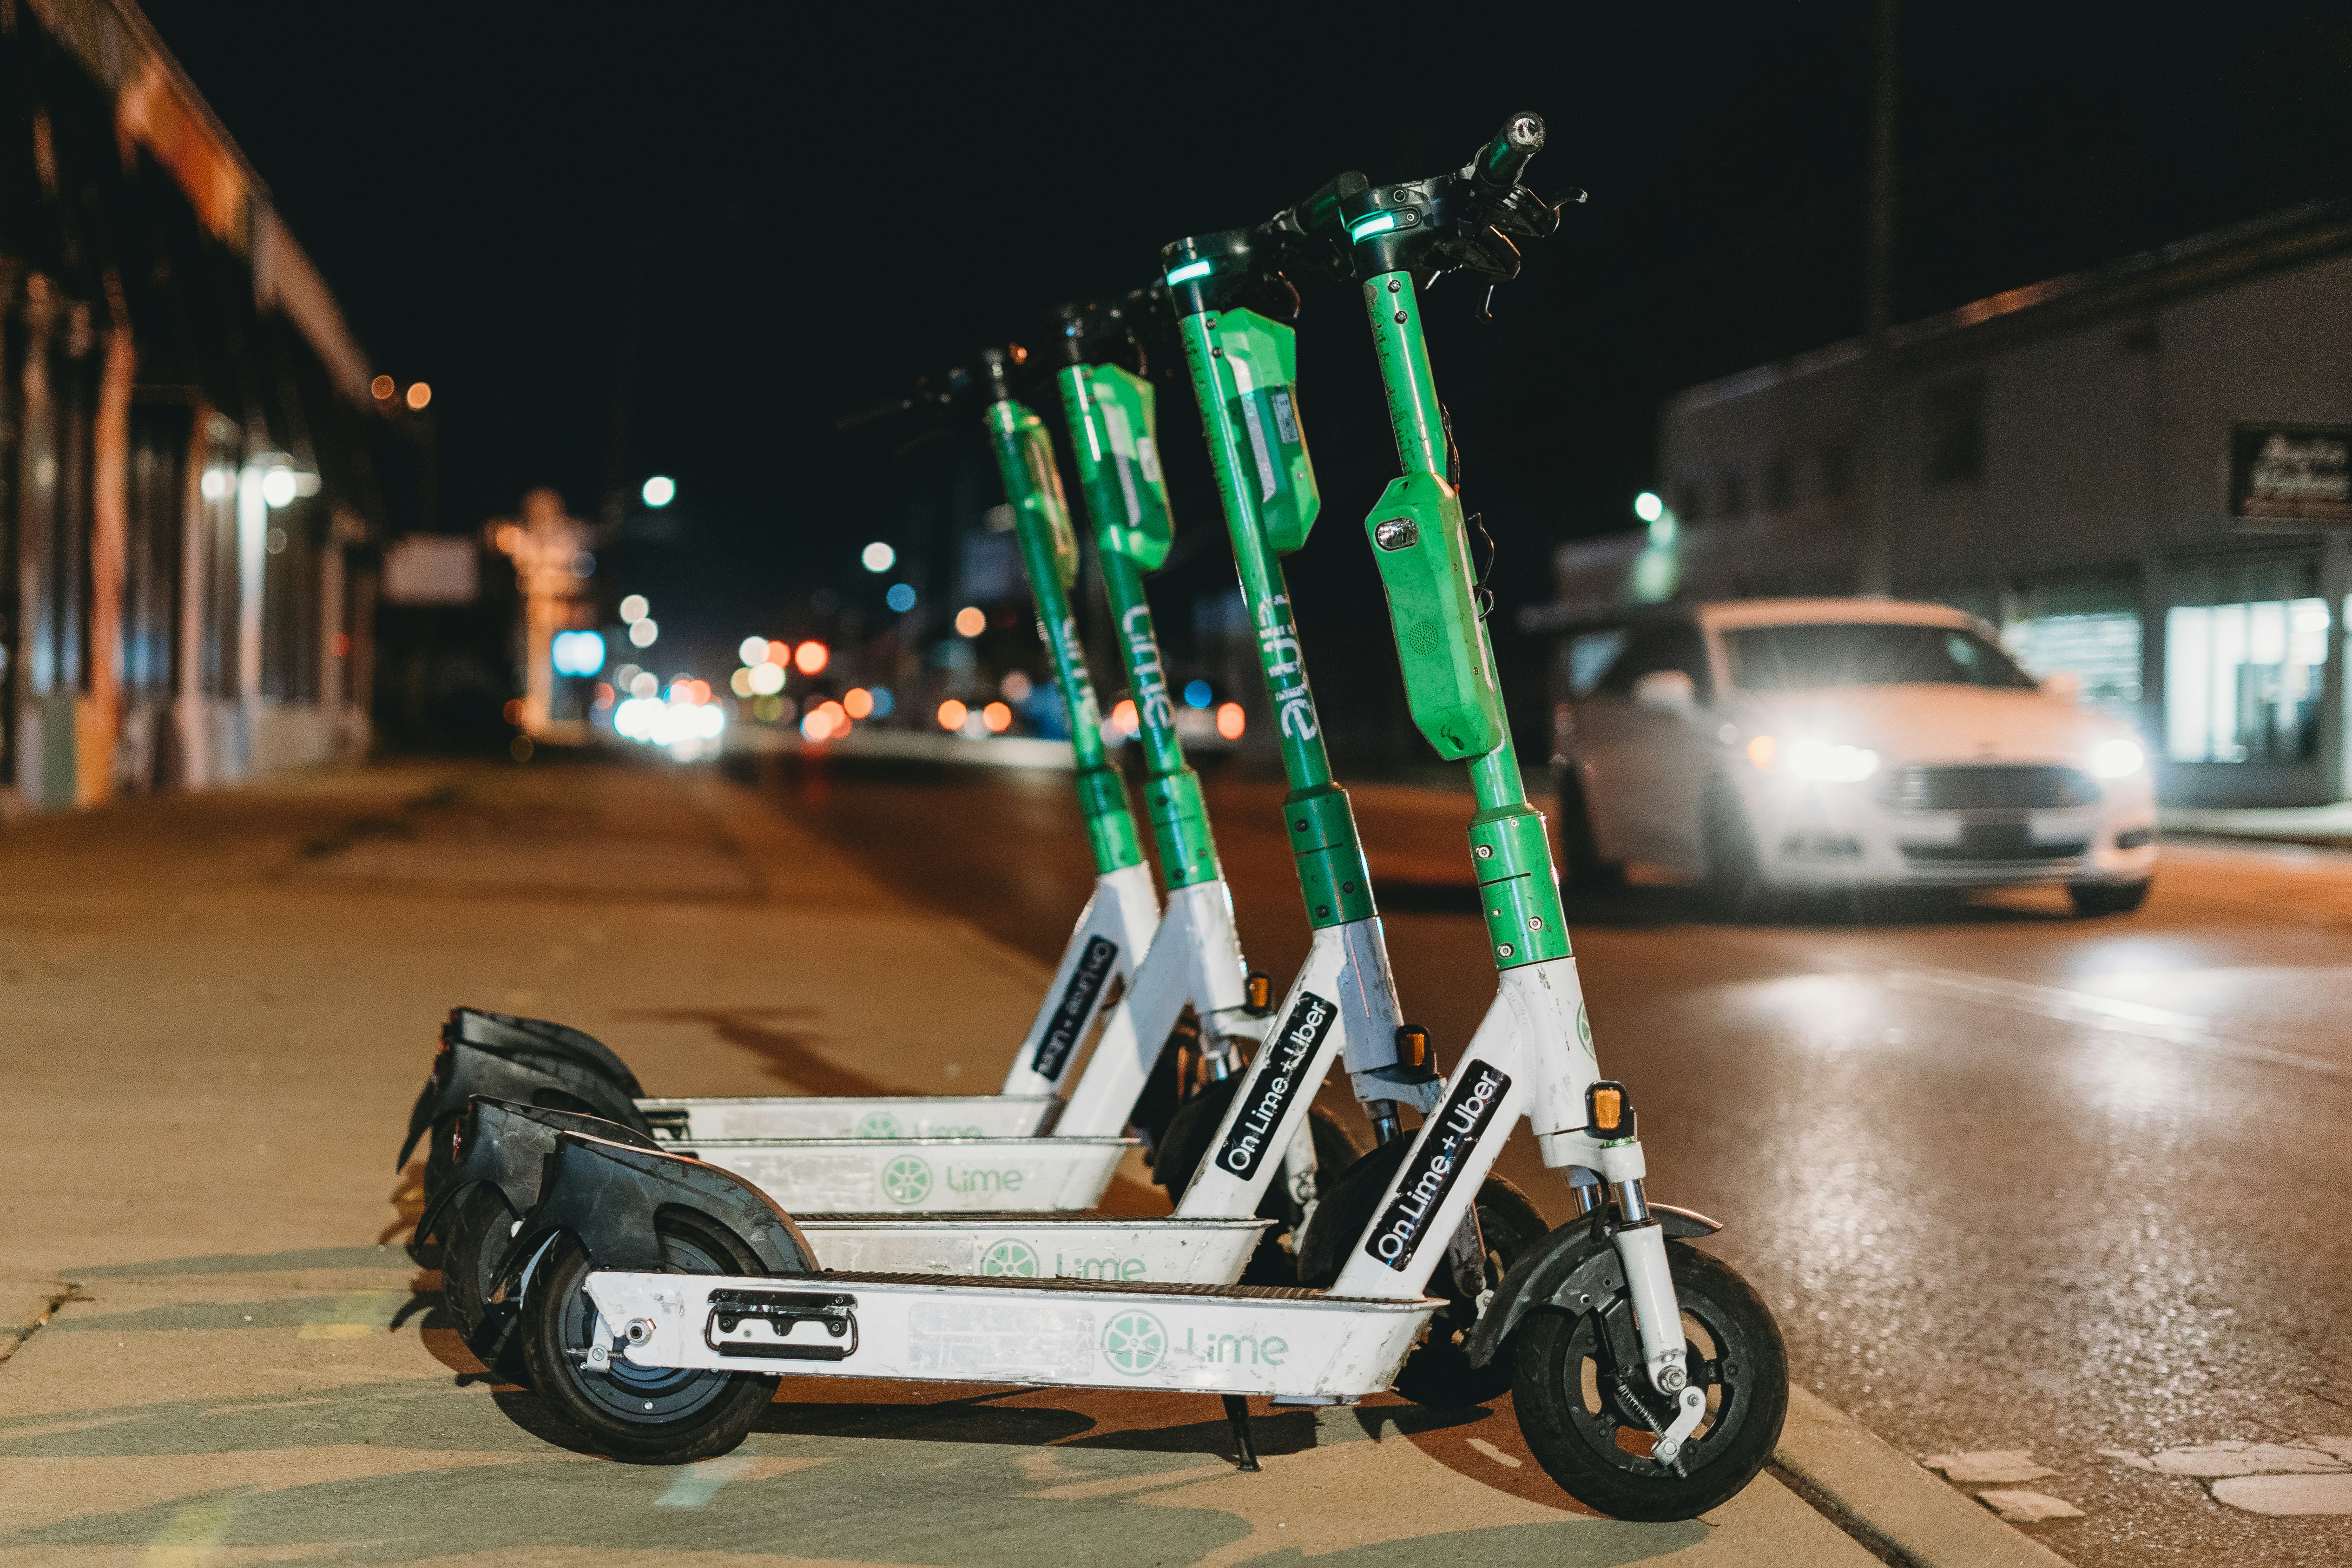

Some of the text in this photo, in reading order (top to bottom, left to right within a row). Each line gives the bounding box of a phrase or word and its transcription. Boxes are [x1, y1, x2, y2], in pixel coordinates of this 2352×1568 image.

[1228, 1135, 1261, 1171] On
[1245, 1077, 1289, 1134] Lime
[1283, 1001, 1327, 1068] Uber
[946, 1166, 1024, 1193] Lime
[1378, 1070, 1498, 1258] On Lime + Uber
[1056, 1253, 1147, 1282] Lime
[1187, 1327, 1289, 1365] Lime
